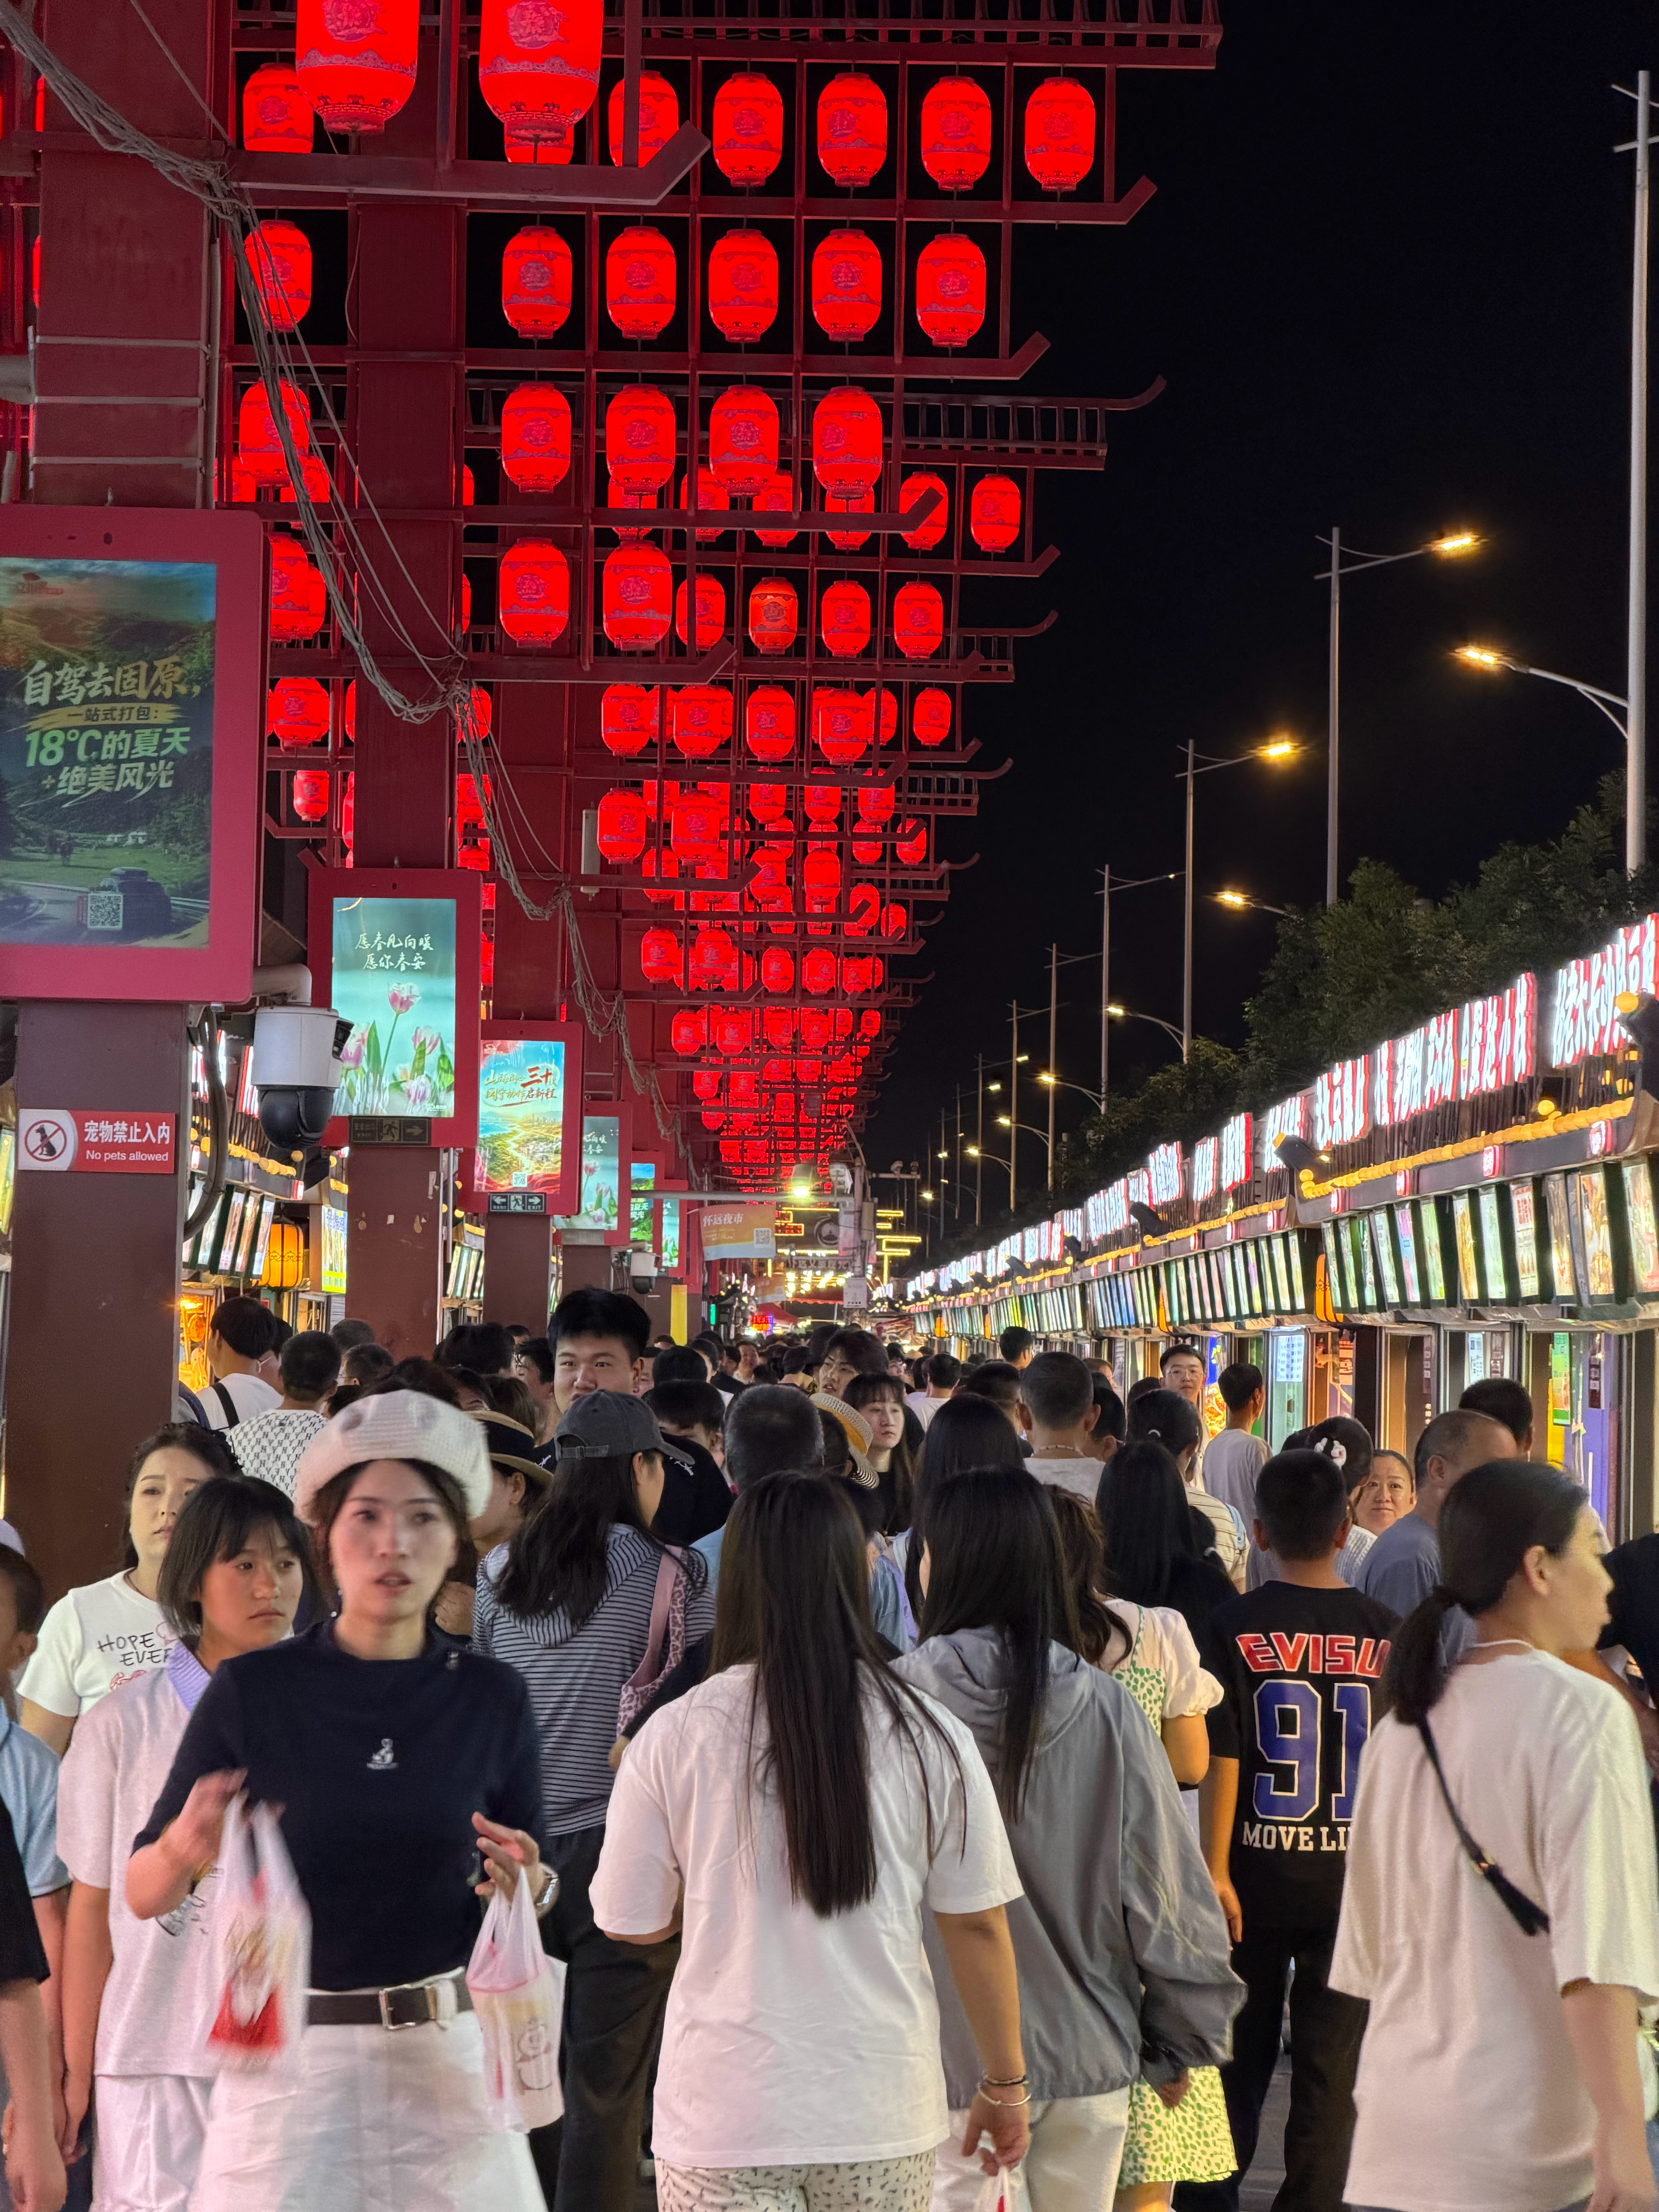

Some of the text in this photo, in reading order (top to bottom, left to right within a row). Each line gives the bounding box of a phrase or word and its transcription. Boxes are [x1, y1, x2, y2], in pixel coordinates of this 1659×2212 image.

[363, 952, 426, 972] 愿你春安
[84, 1120, 170, 1145] 宠物禁止入内
[86, 1150, 169, 1162] No pets allowed
[702, 1212, 744, 1227] 怀远夜市
[98, 1632, 155, 1652] HOPE
[1235, 1632, 1391, 1678] EVISU
[1253, 1679, 1371, 1822] 91
[1242, 1821, 1314, 1851] MOVE
